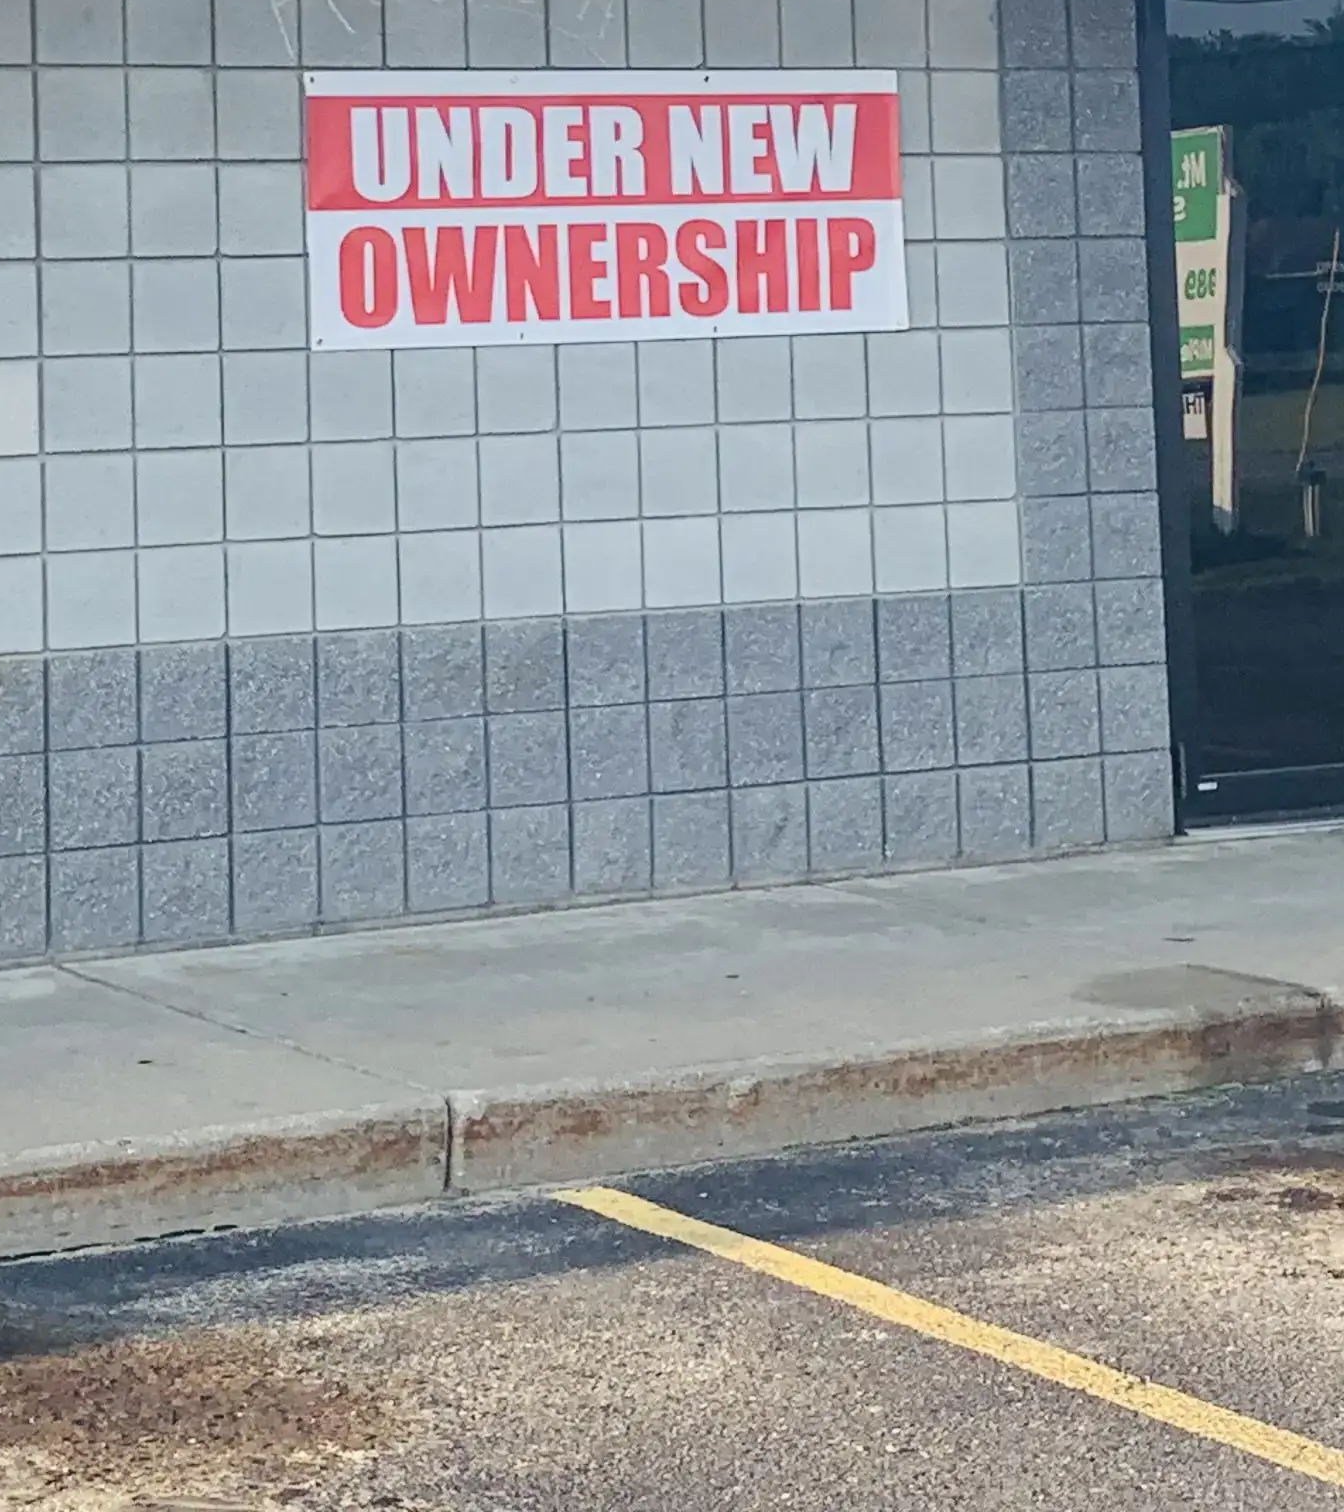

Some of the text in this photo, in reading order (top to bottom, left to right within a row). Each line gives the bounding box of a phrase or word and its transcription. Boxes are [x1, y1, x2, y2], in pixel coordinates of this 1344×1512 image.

[350, 103, 857, 202] UNDER NEW
[338, 217, 877, 329] OWNERSHIP
